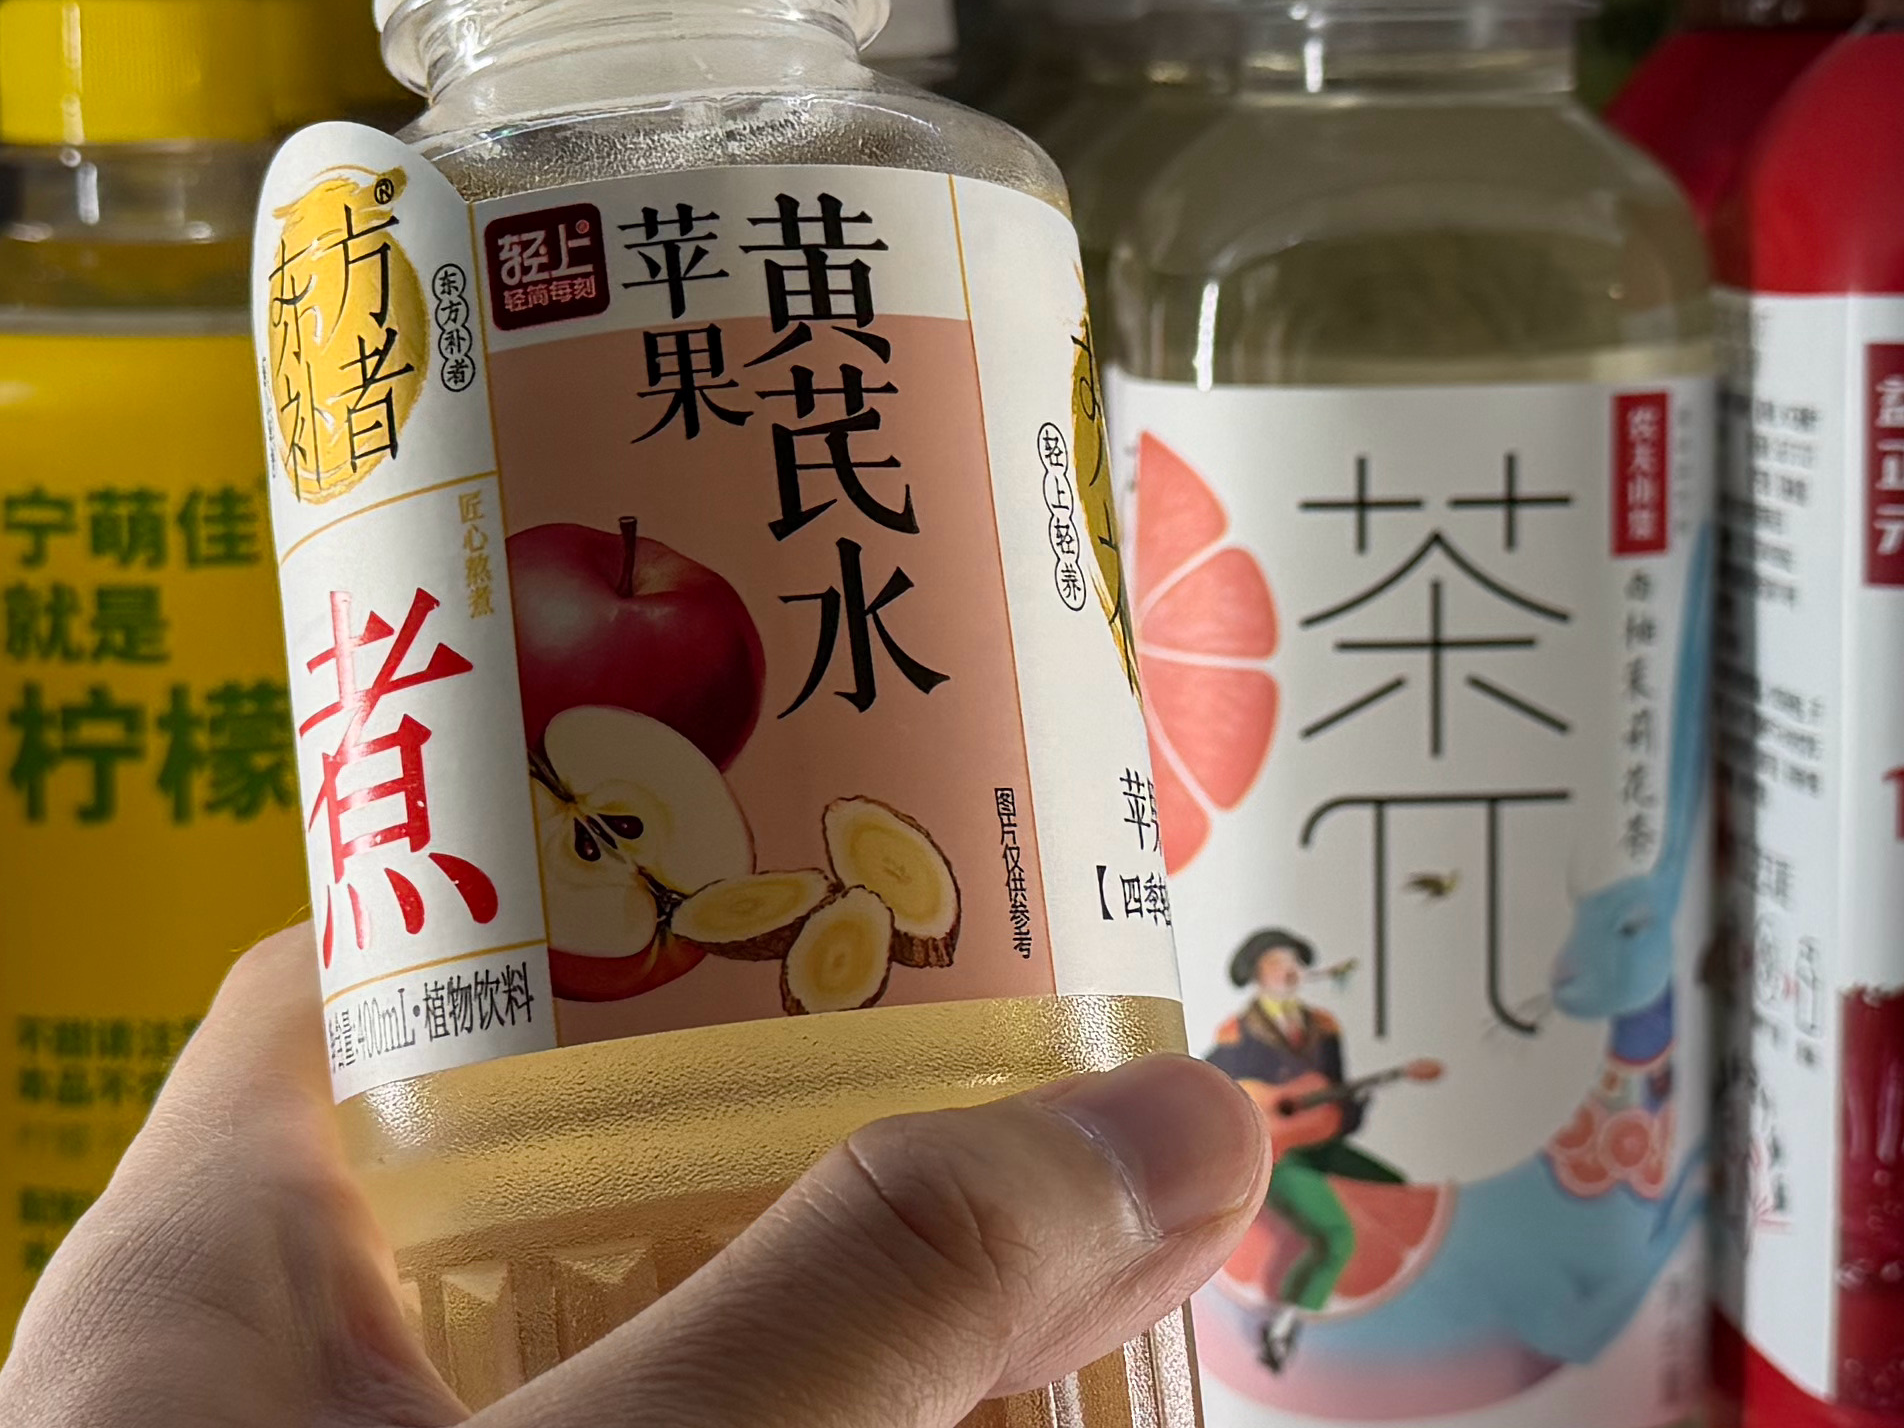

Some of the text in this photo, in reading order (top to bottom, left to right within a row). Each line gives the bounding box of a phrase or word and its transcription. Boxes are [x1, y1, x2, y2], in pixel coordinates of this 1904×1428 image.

[432, 264, 476, 392] 东方补者
[497, 222, 594, 286] 轻上
[503, 274, 597, 312] 轻简每刻
[616, 202, 755, 446] 苹果
[1, 486, 261, 569] 宁萌佳
[738, 192, 951, 721] 黄芪水
[1040, 426, 1082, 604] 轻上轻养
[0, 581, 172, 667] 就是
[7, 680, 296, 830] 柠檬
[299, 587, 500, 970] 煮
[994, 787, 1033, 960] 图片仅供参考
